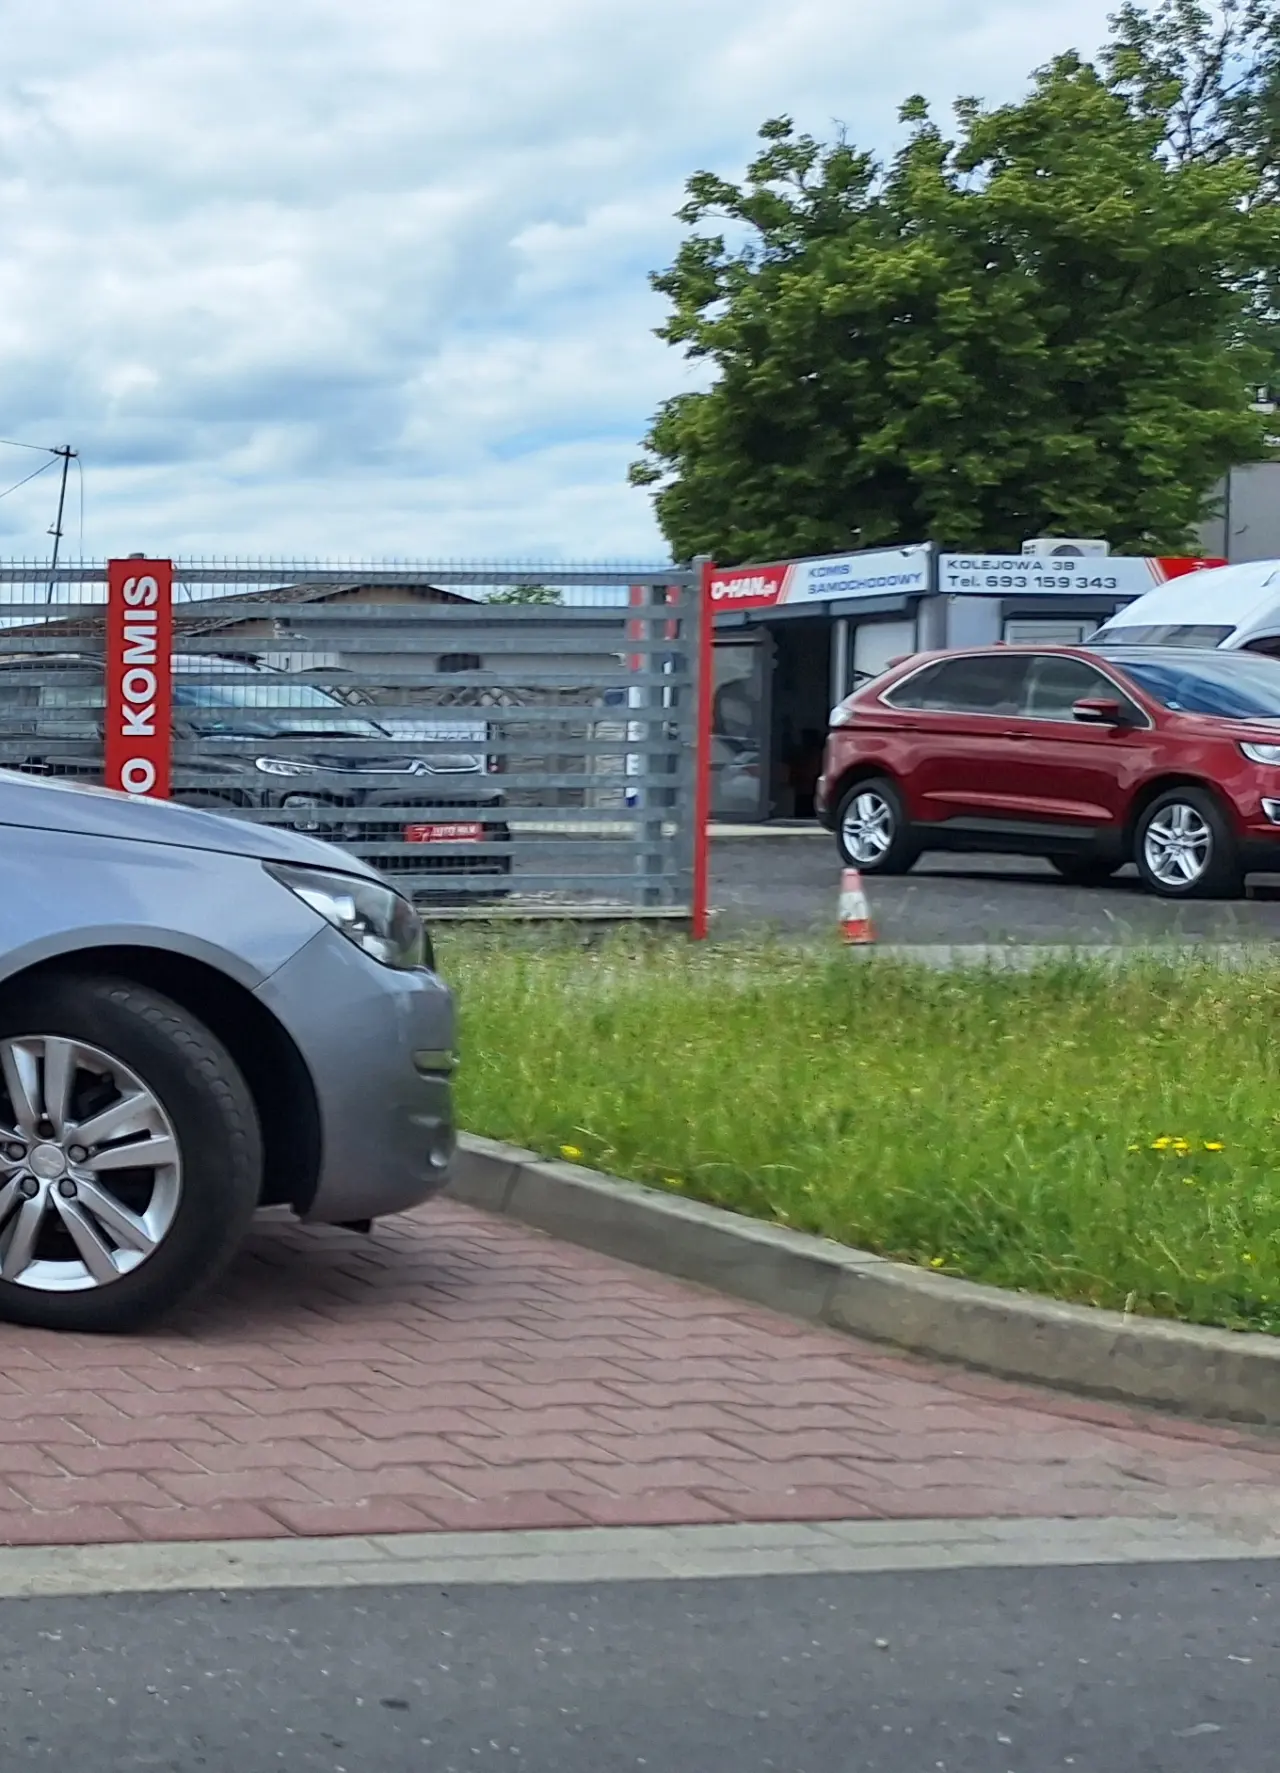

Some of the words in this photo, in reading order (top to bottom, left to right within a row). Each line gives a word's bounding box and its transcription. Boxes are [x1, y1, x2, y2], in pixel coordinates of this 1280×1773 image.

[809, 564, 850, 577] KOMIS
[947, 560, 1043, 571] KOLEJOWA
[808, 572, 922, 594] SAMOCHODOWY
[947, 575, 980, 587] Tel.
[986, 576, 1027, 588] 693
[1034, 577, 1071, 588] 159
[1075, 577, 1117, 589] 343
[122, 576, 159, 736] KOMIS
